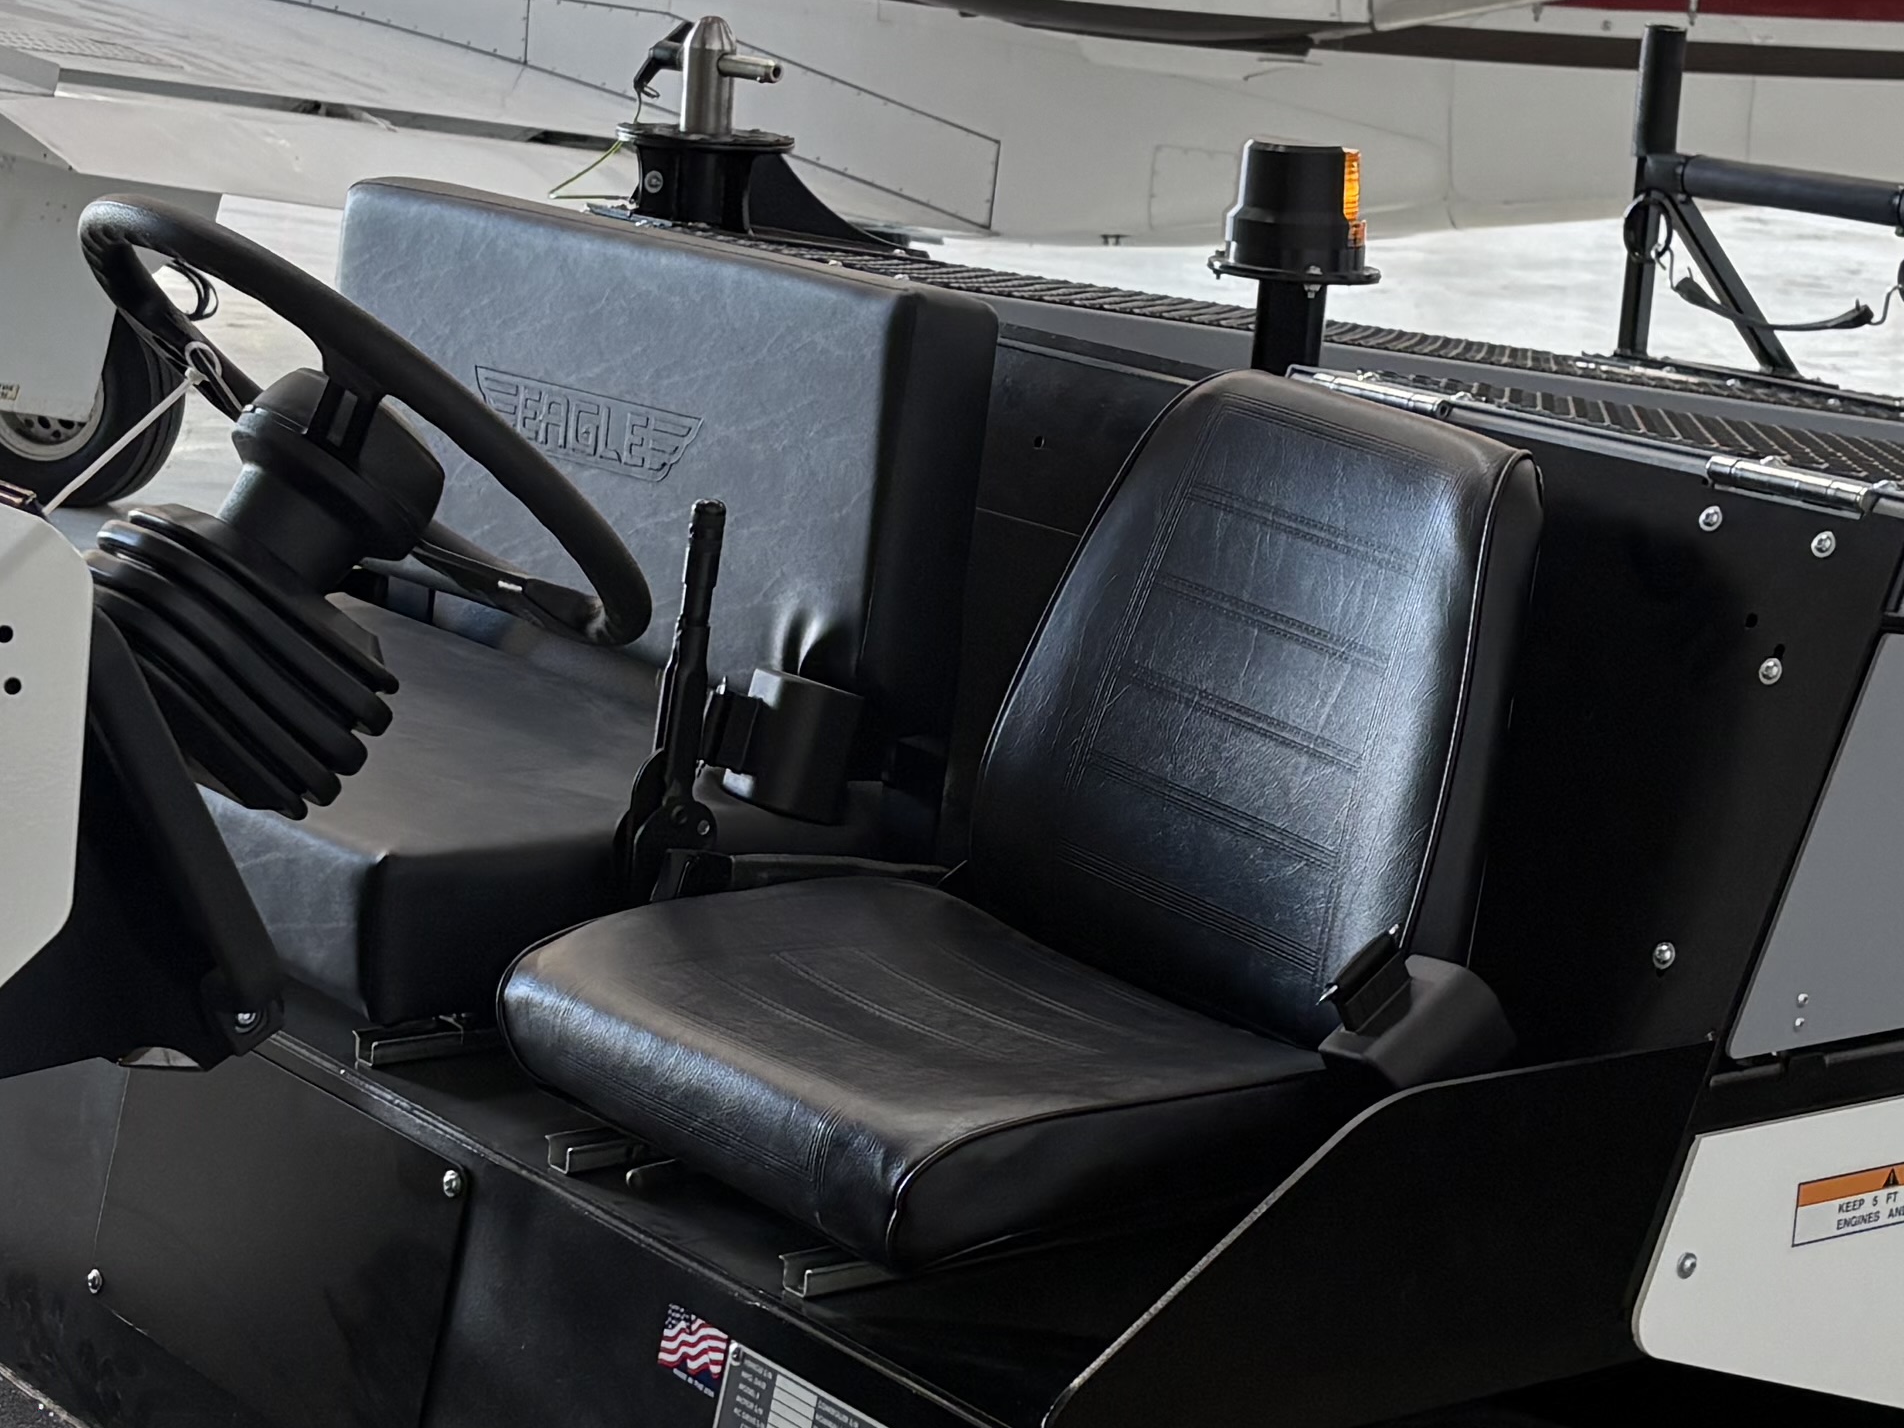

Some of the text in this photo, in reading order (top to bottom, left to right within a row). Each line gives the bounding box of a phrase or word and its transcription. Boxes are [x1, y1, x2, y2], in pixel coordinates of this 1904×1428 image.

[516, 384, 650, 469] EAGLE
[1838, 1197, 1865, 1214] KEEP
[1871, 1195, 1879, 1208] 5
[1886, 1190, 1899, 1204] FT
[1836, 1211, 1881, 1231] ENGINES
